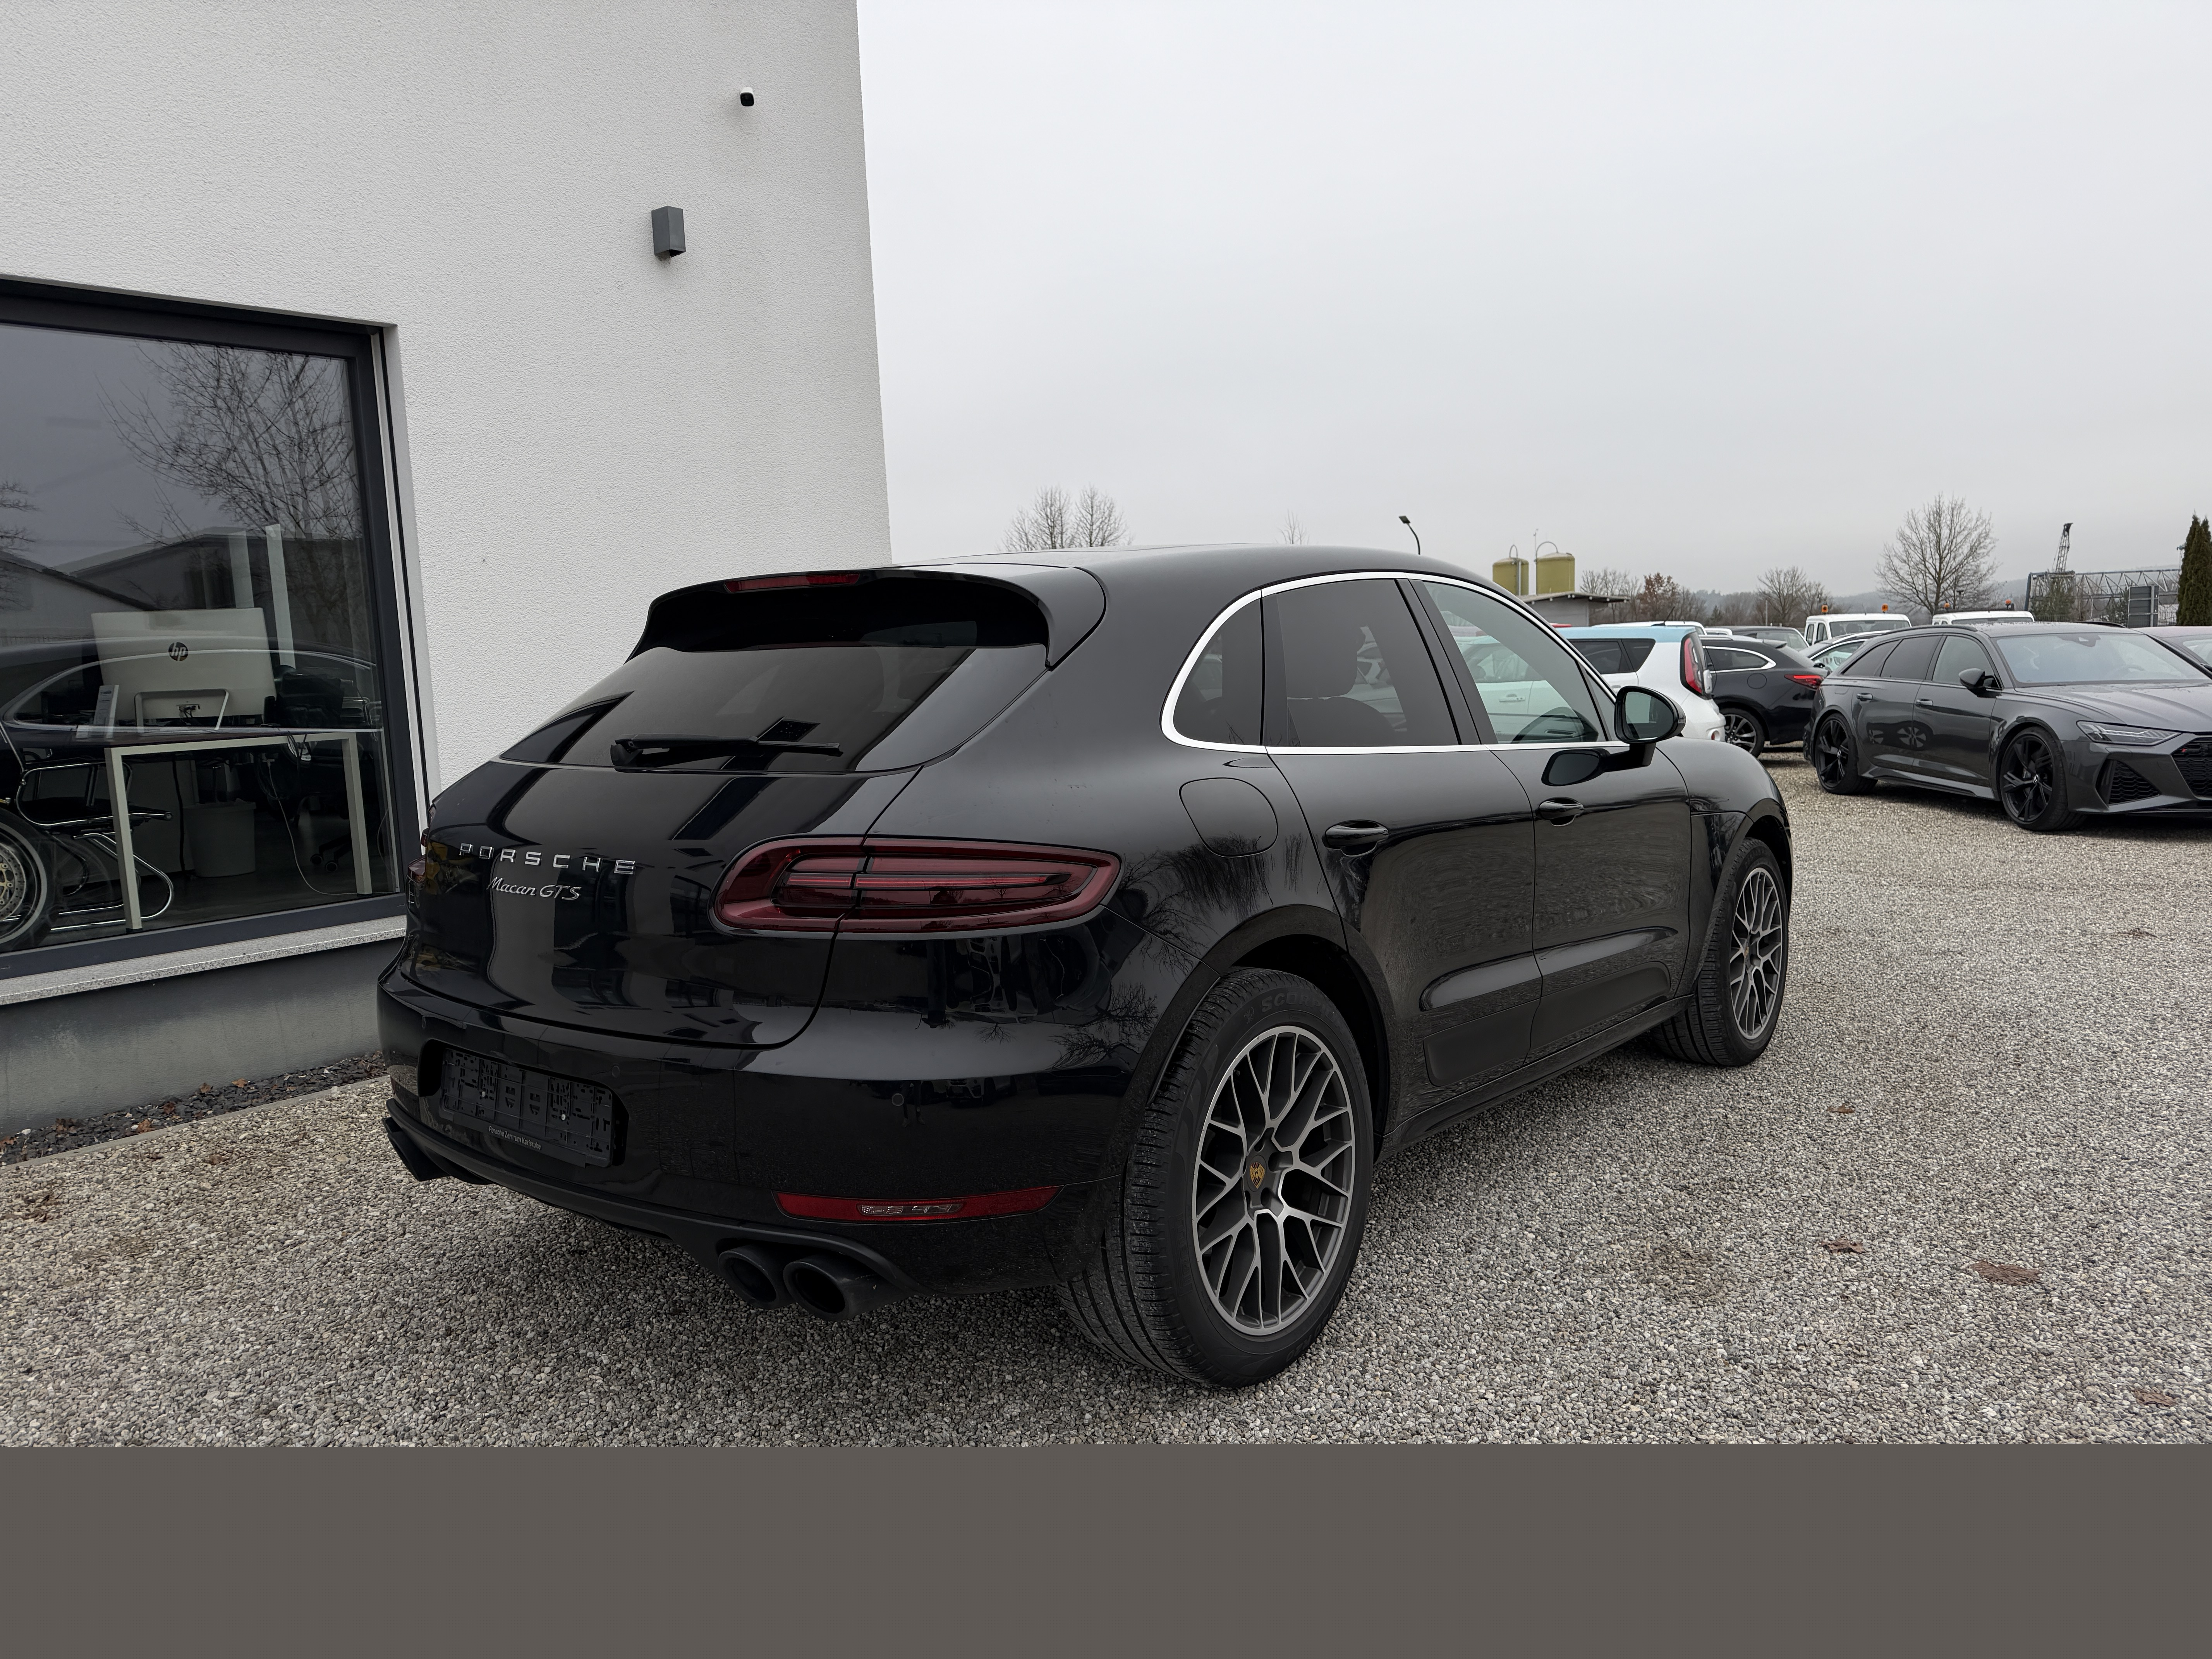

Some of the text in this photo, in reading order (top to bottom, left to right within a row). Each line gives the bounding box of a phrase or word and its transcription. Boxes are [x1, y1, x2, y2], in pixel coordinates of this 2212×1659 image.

[170, 642, 186, 661] hp
[459, 842, 636, 875] PORSCHE
[486, 877, 581, 900] Macan GTS
[489, 1126, 541, 1150] Porsche Zentrum Karlsruhe
